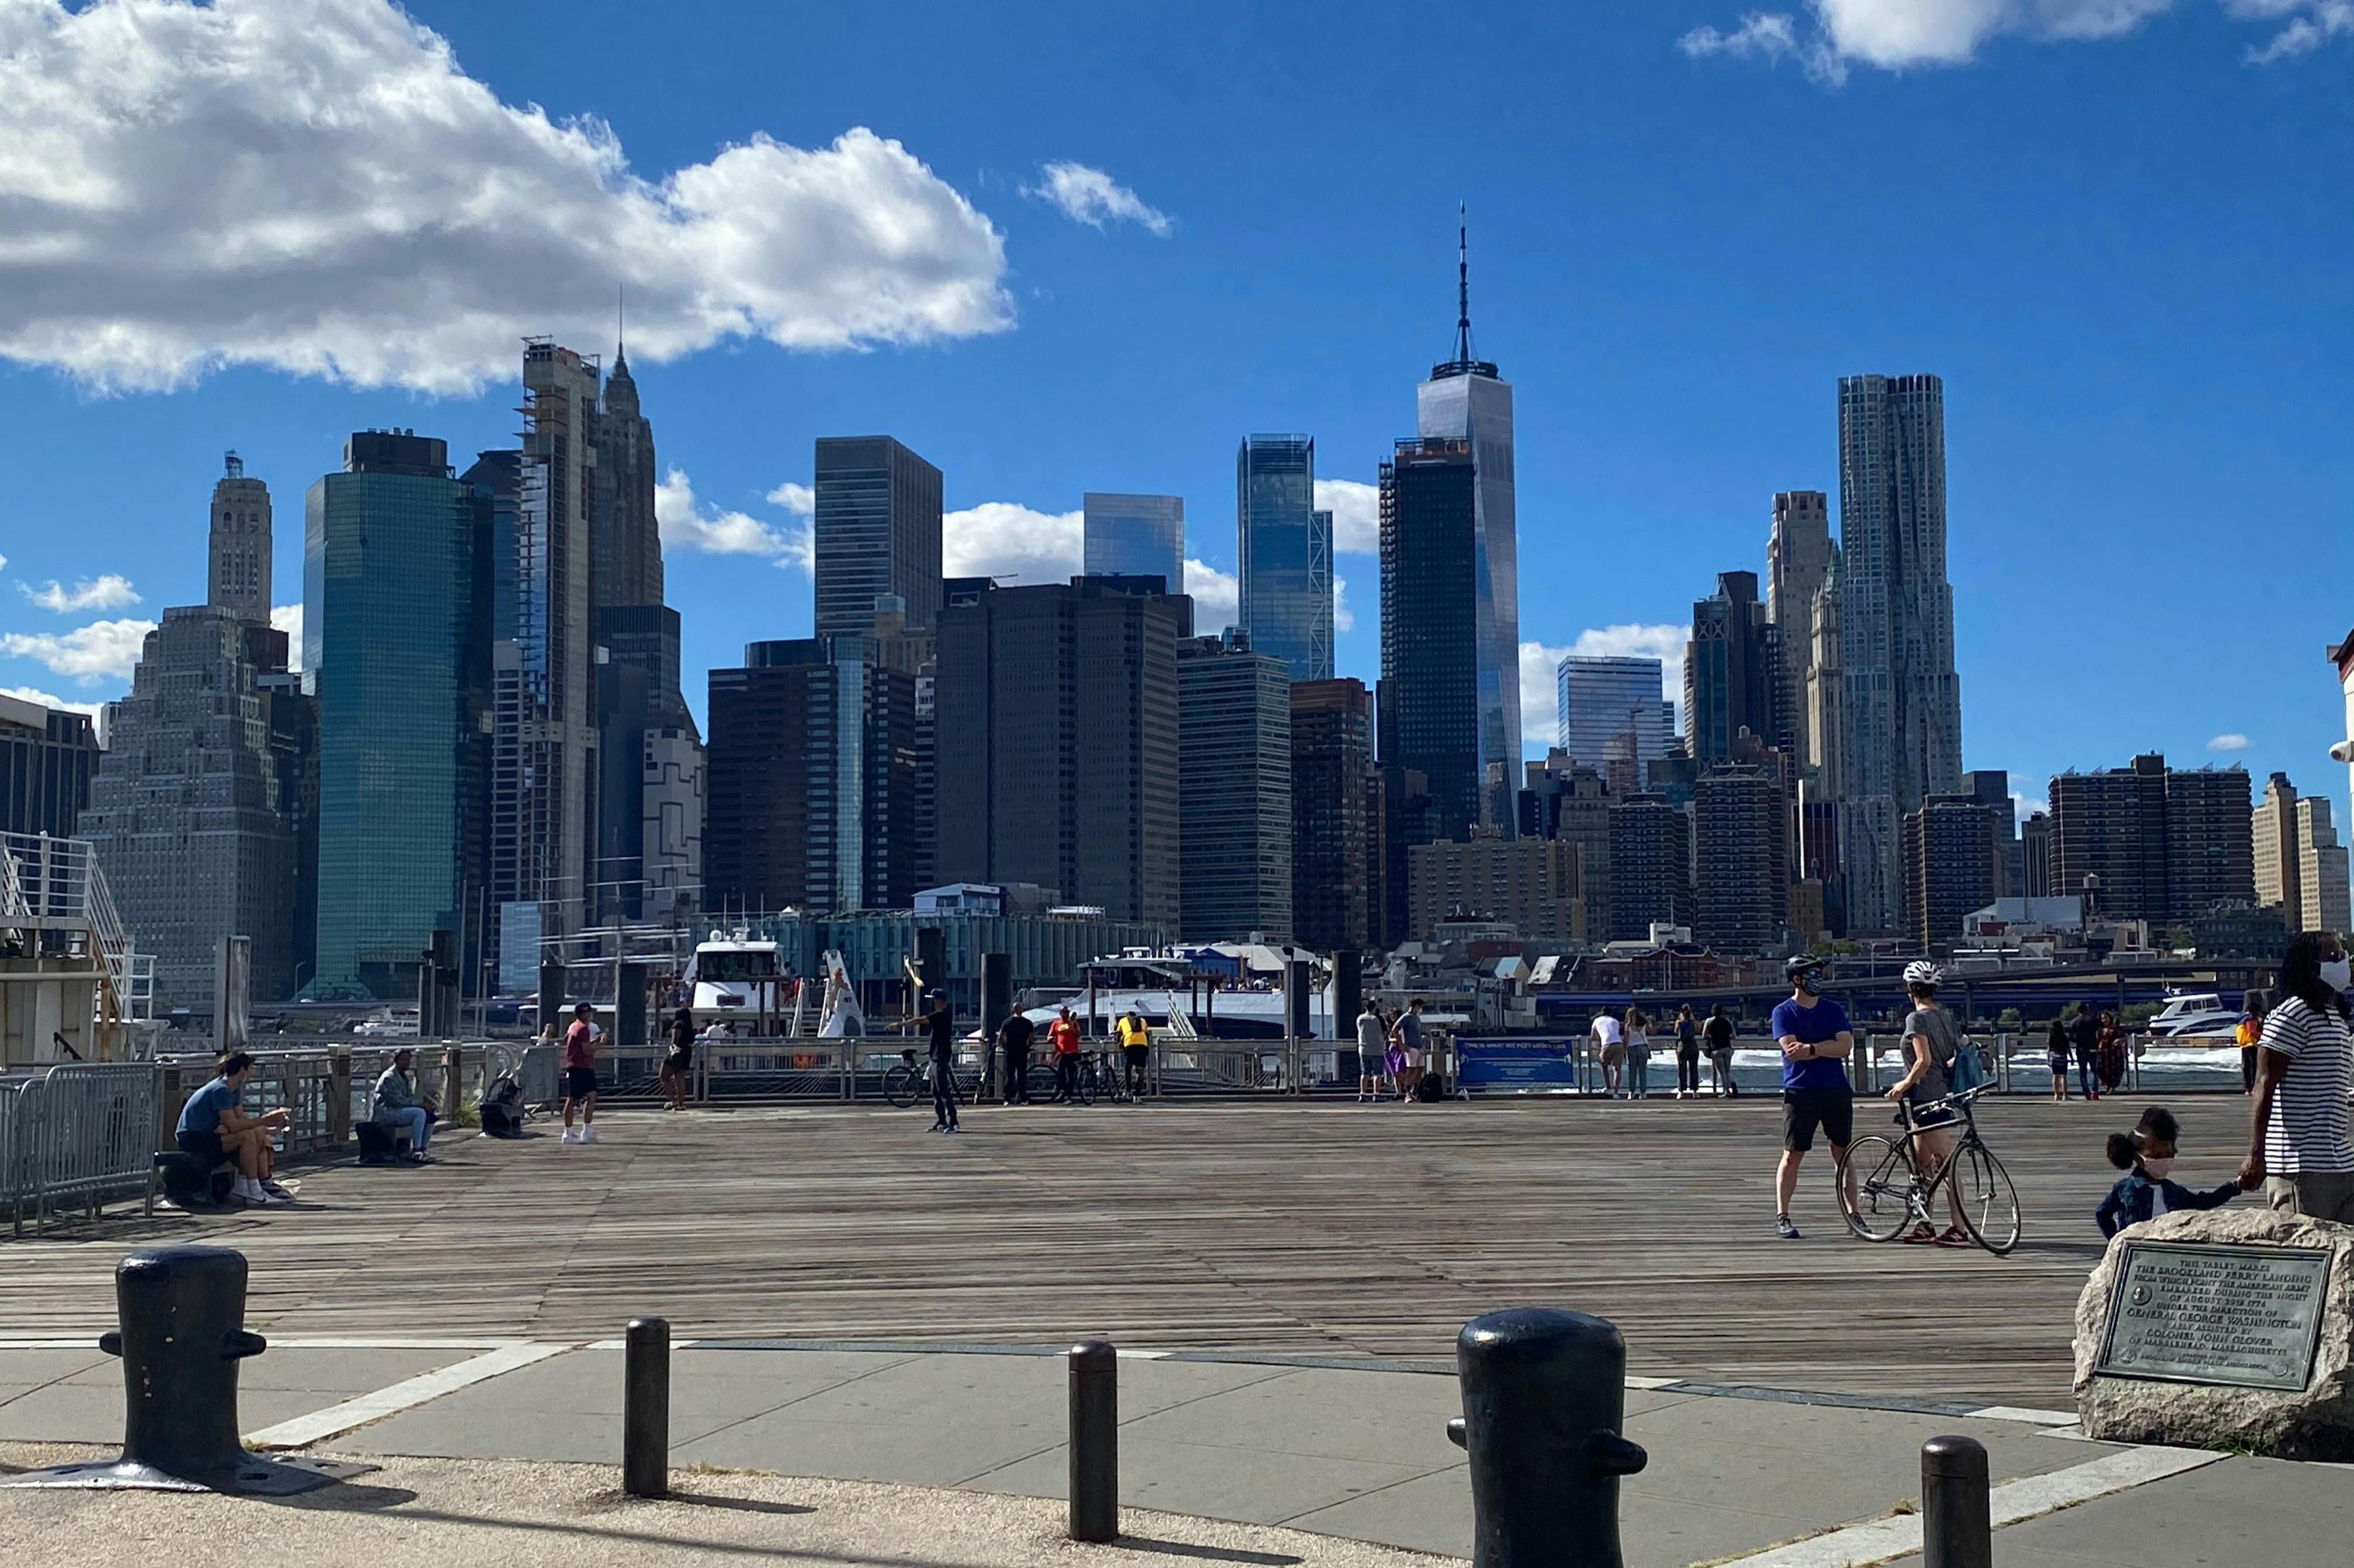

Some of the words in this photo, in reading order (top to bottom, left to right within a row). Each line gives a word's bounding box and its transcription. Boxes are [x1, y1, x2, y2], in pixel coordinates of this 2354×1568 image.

[2136, 1265, 2155, 1273] THE
[2157, 1267, 2221, 1277] BROOKLAND
[2224, 1271, 2258, 1280] FERRY
[2262, 1273, 2312, 1283] LANDING
[2160, 1285, 2211, 1294] EMBARKED
[2214, 1289, 2252, 1297] DURING
[2157, 1302, 2189, 1311] UNDER
[2210, 1306, 2262, 1315] DIRECTION
[2127, 1308, 2176, 1320] GENERAL
[2179, 1312, 2223, 1324] GEORGE
[2228, 1316, 2302, 1329] WASHINGTON
[2195, 1325, 2237, 1333] ASSISTED
[2147, 1329, 2195, 1339] COLONEL
[2198, 1333, 2228, 1342] JOHN
[2233, 1336, 2273, 1346] GLOVER
